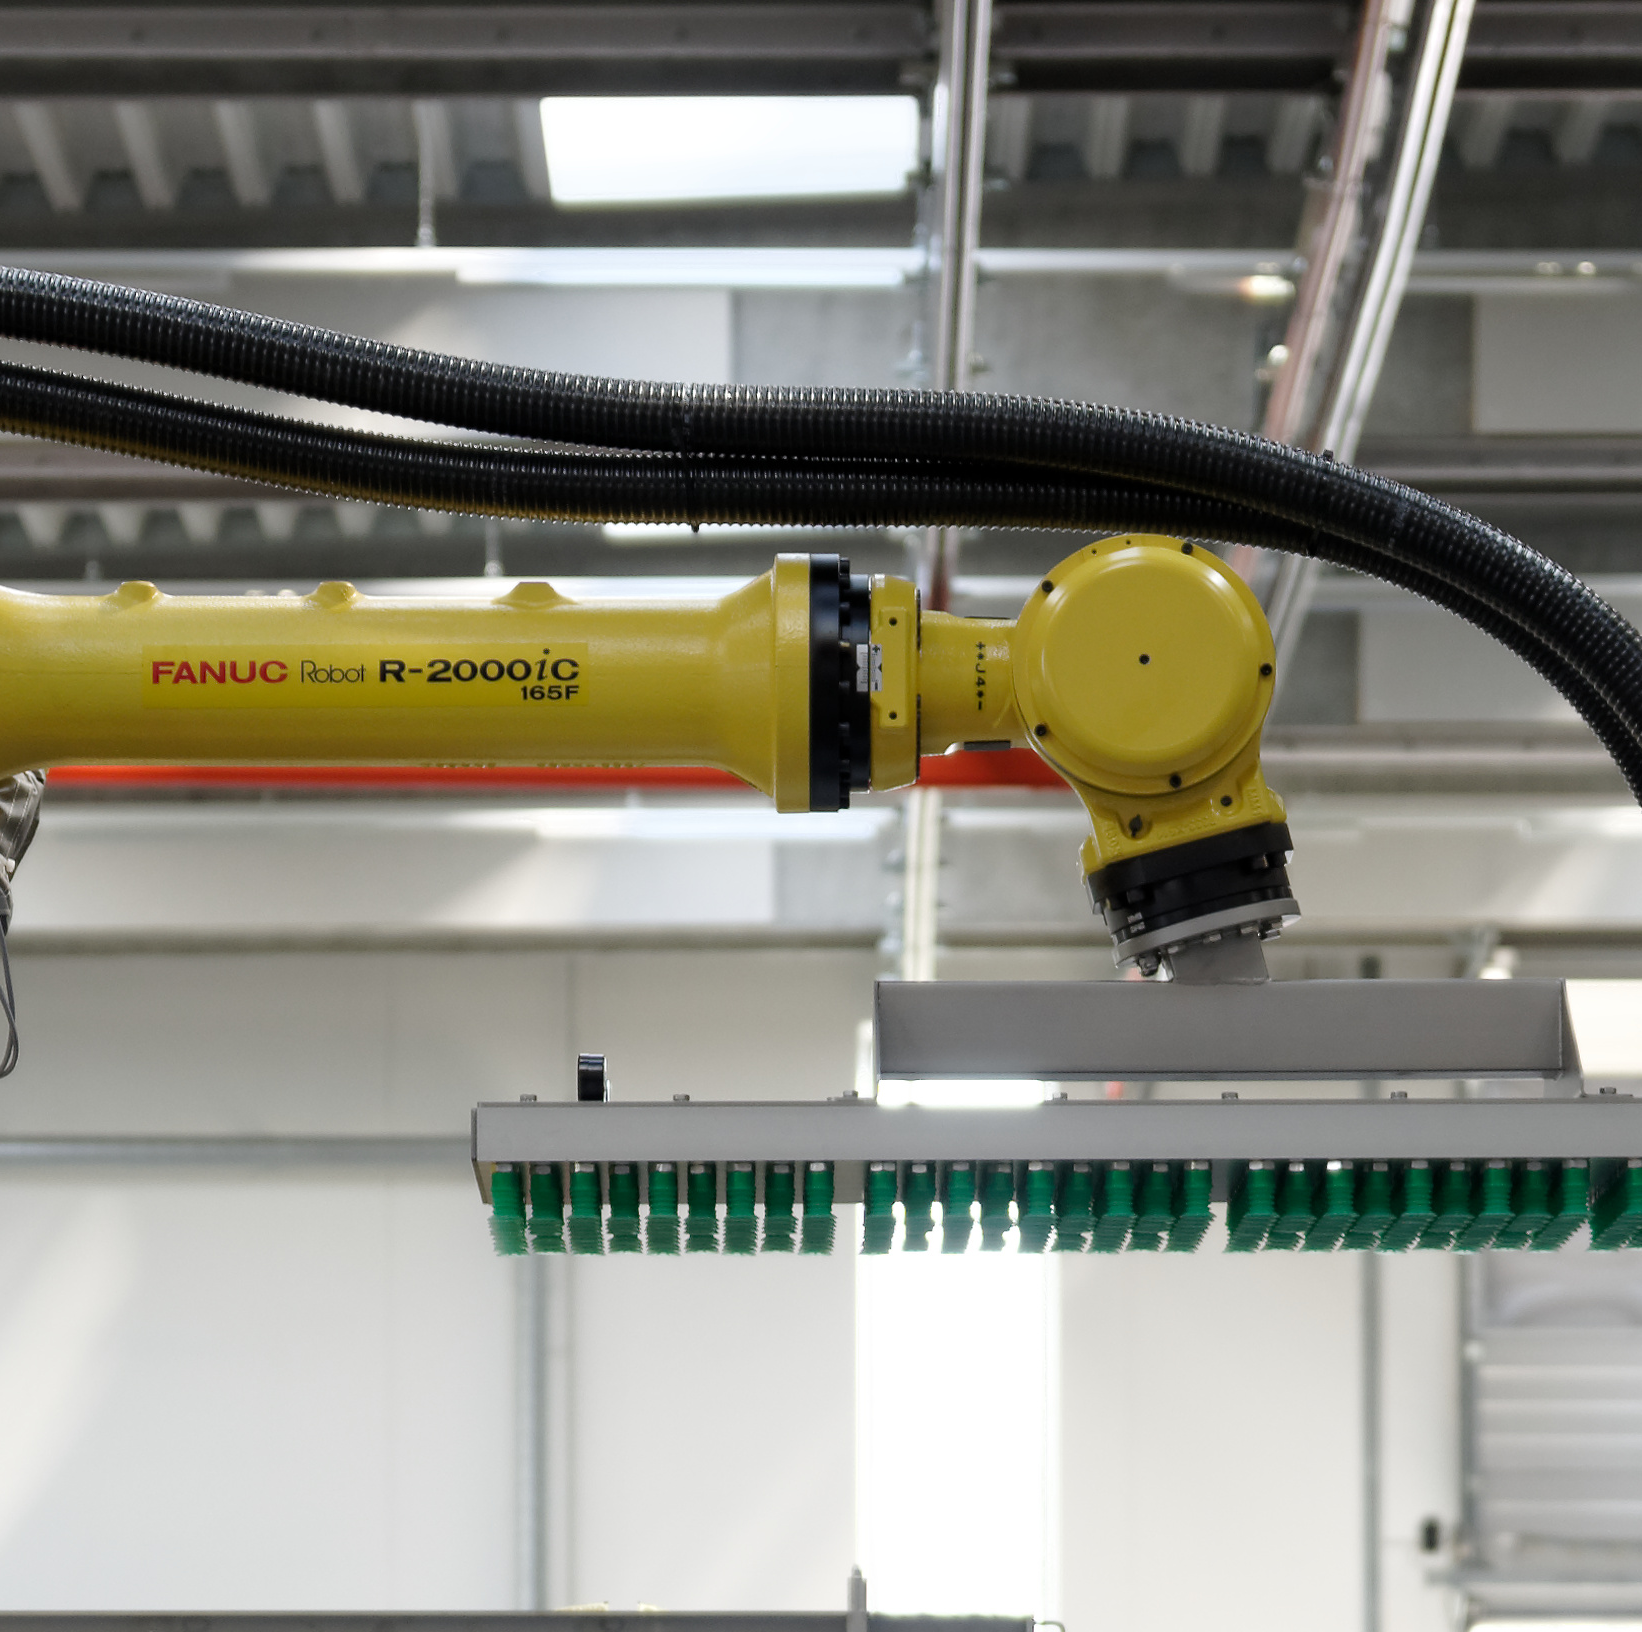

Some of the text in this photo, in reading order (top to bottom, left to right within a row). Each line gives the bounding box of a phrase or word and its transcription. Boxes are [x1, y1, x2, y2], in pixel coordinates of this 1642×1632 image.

[152, 648, 579, 684] FANUC Robot R-2000iC
[520, 685, 579, 701] 165F
